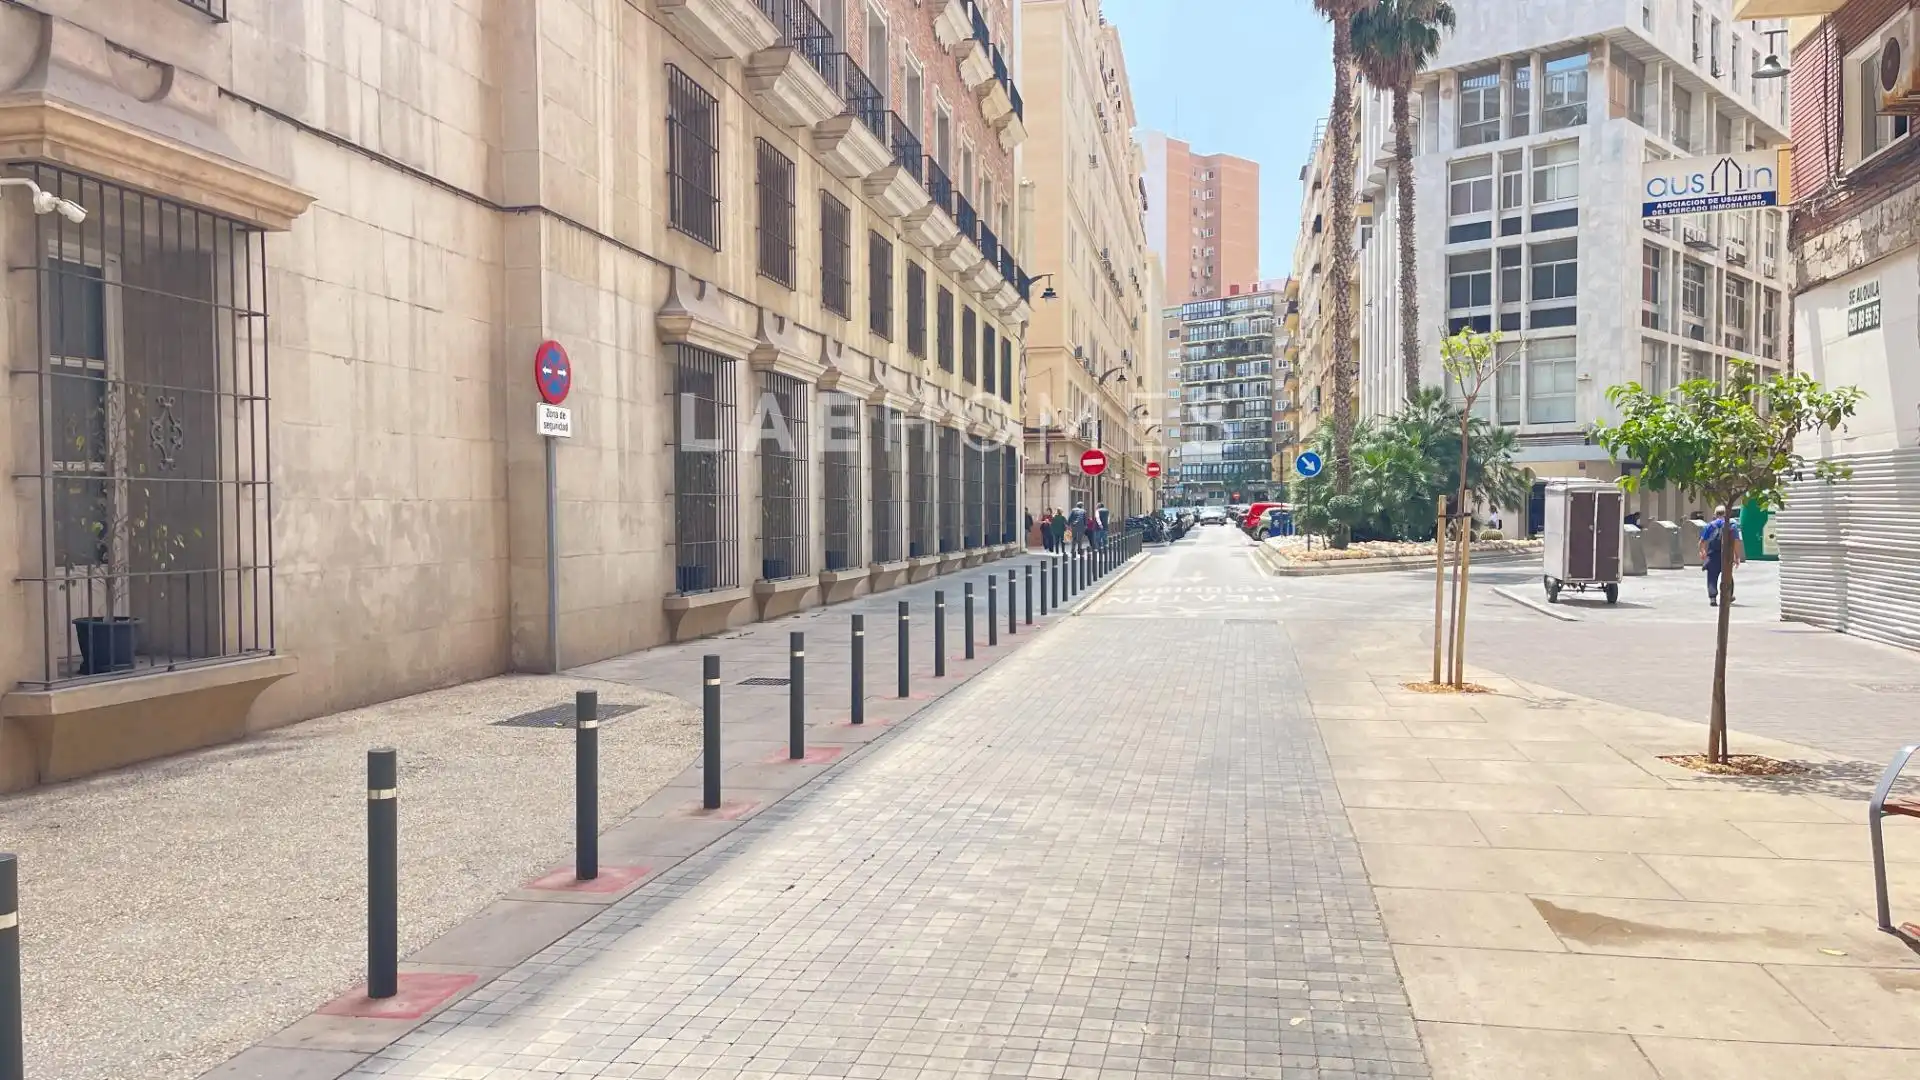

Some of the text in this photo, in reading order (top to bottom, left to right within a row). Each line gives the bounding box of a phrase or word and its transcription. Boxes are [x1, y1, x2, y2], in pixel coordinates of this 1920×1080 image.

[1707, 197, 1719, 205] DE
[1721, 193, 1762, 203] USUARIOS
[1652, 200, 1766, 216] DEL MERCADO INMOBILIARIO
[546, 407, 559, 418] Zona
[543, 421, 569, 432] seguridad
